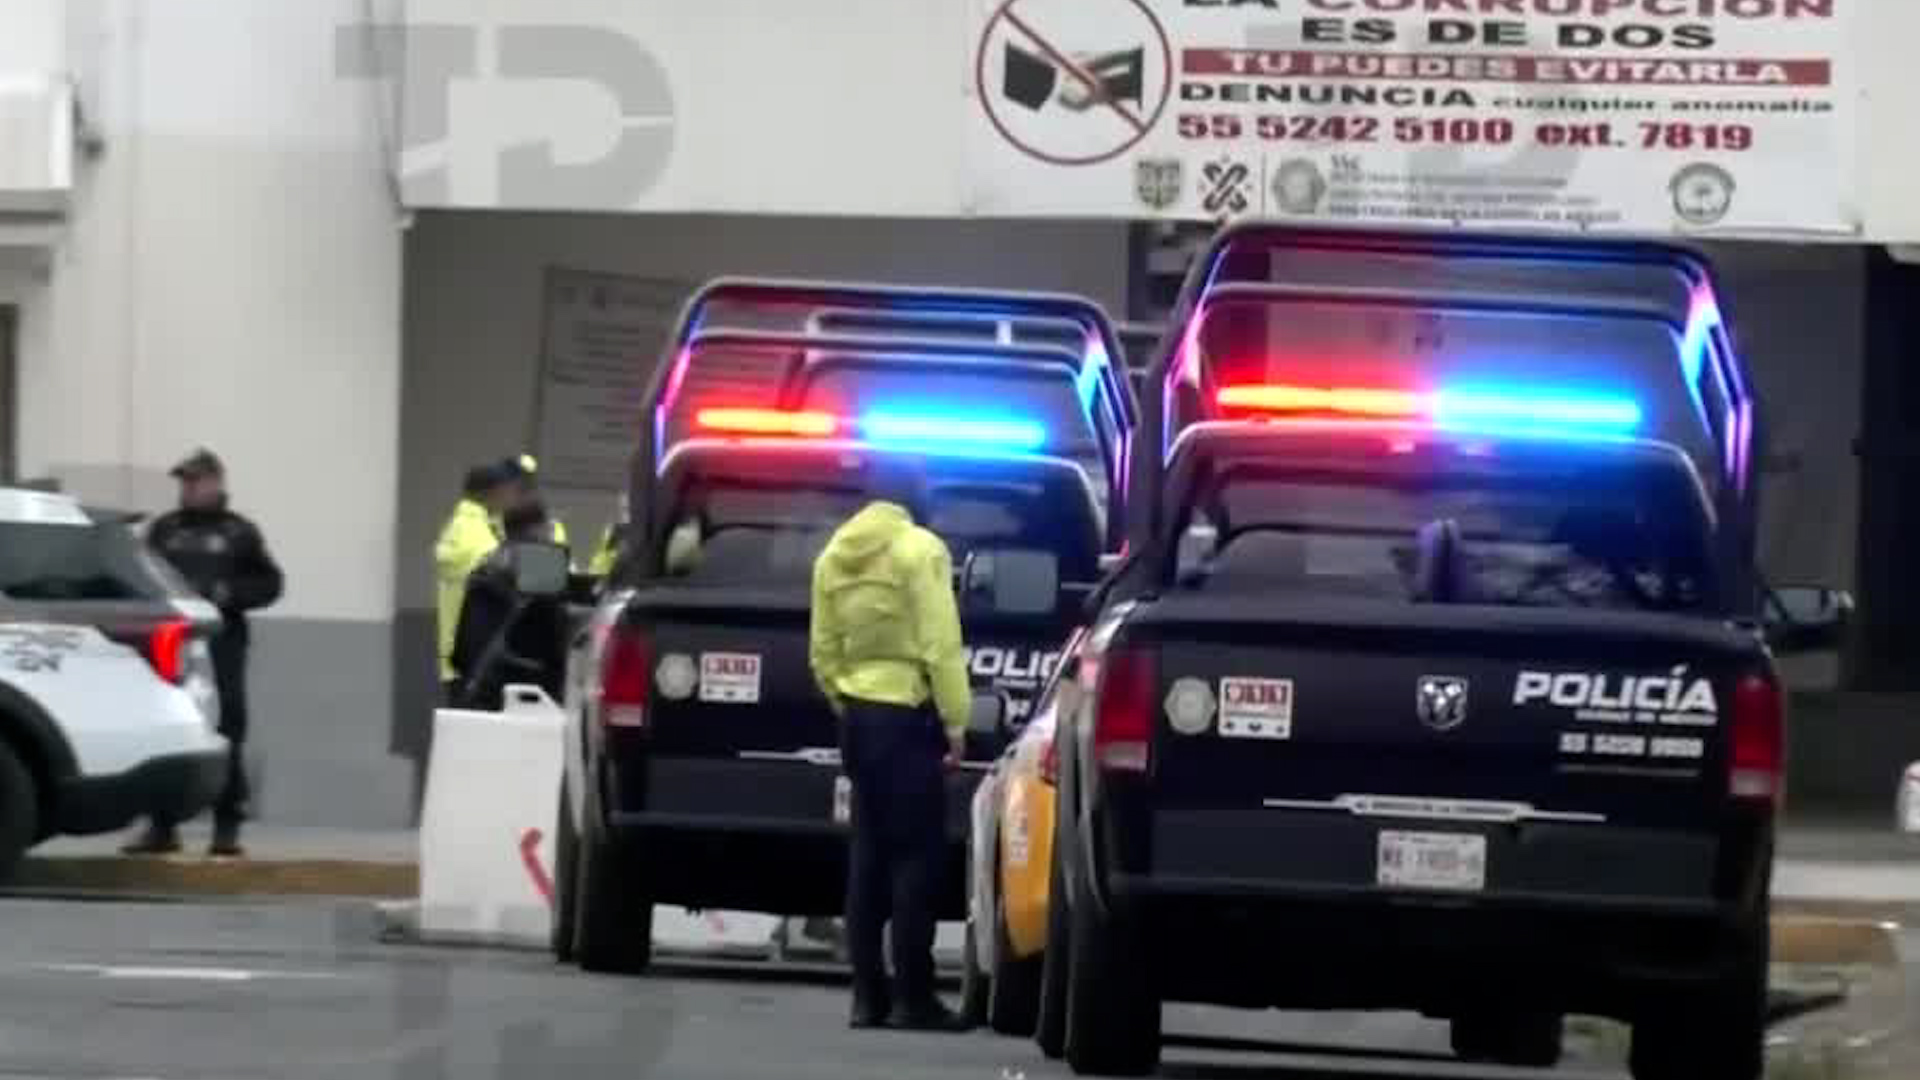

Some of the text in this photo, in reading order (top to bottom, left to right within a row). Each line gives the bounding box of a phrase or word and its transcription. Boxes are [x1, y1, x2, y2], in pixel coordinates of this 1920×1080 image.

[1302, 17, 1715, 48] ES DE DOS
[1228, 51, 1788, 83] TU PUEDES EVITARLA
[1180, 83, 1476, 107] DENUNCIA
[1178, 114, 1753, 150] 55 5242 5100 ext. 7819
[1513, 663, 1717, 711] POLICÍA
